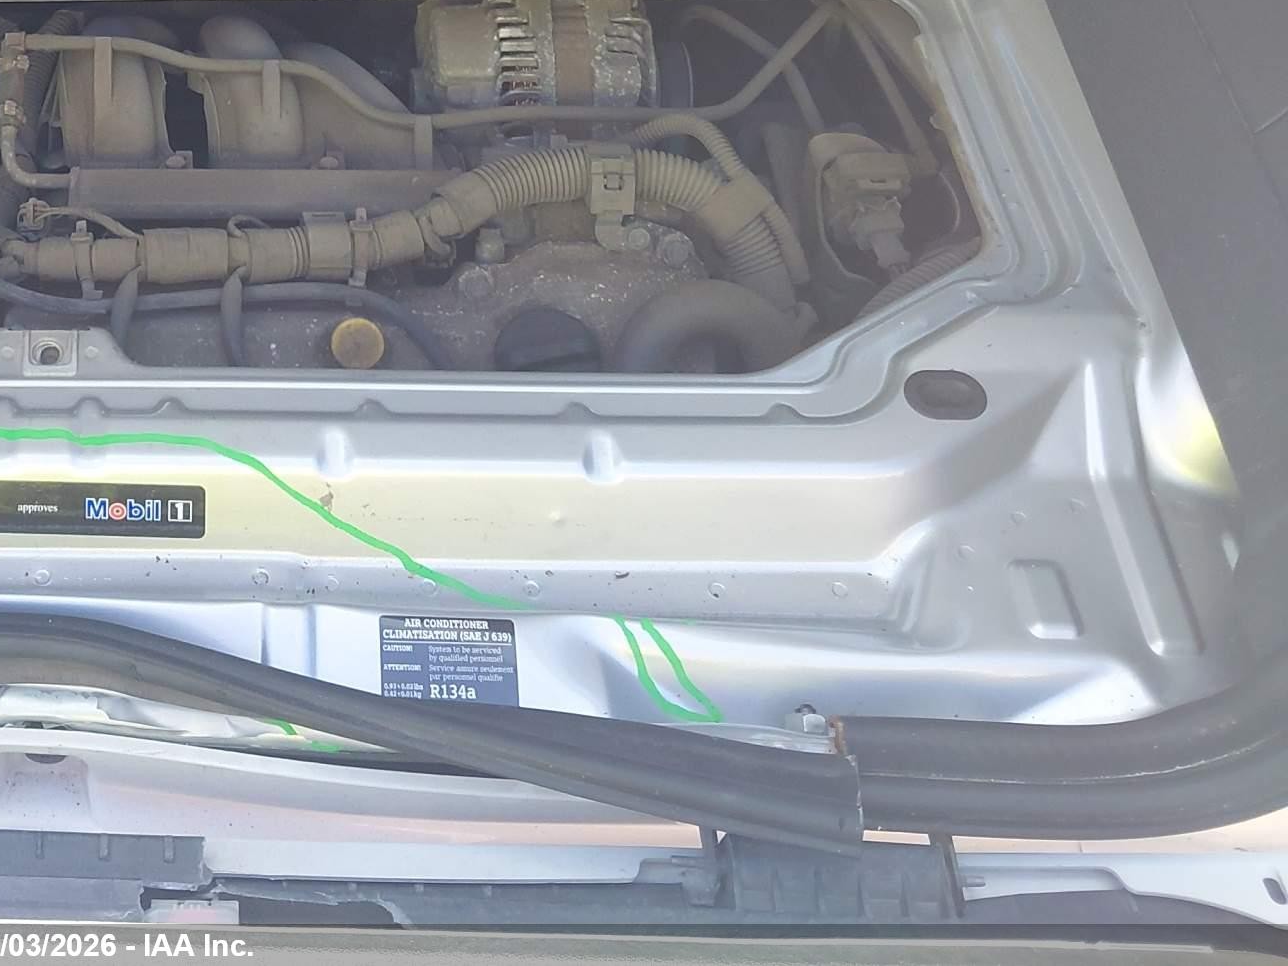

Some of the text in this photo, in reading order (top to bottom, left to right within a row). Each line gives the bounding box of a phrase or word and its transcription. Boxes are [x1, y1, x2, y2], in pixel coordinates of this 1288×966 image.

[17, 503, 58, 514] approves
[85, 497, 161, 522] Mobil
[404, 618, 489, 630] AIR CONDITIONER
[383, 629, 512, 643] CLIMATISATION (SAE J 639)
[428, 645, 451, 655] System
[462, 646, 470, 654] be
[471, 646, 502, 654] serviced
[428, 654, 437, 663] by
[439, 655, 468, 663] qualified
[428, 664, 454, 672] Service
[442, 674, 476, 682] personnel
[429, 684, 477, 699] R134a
